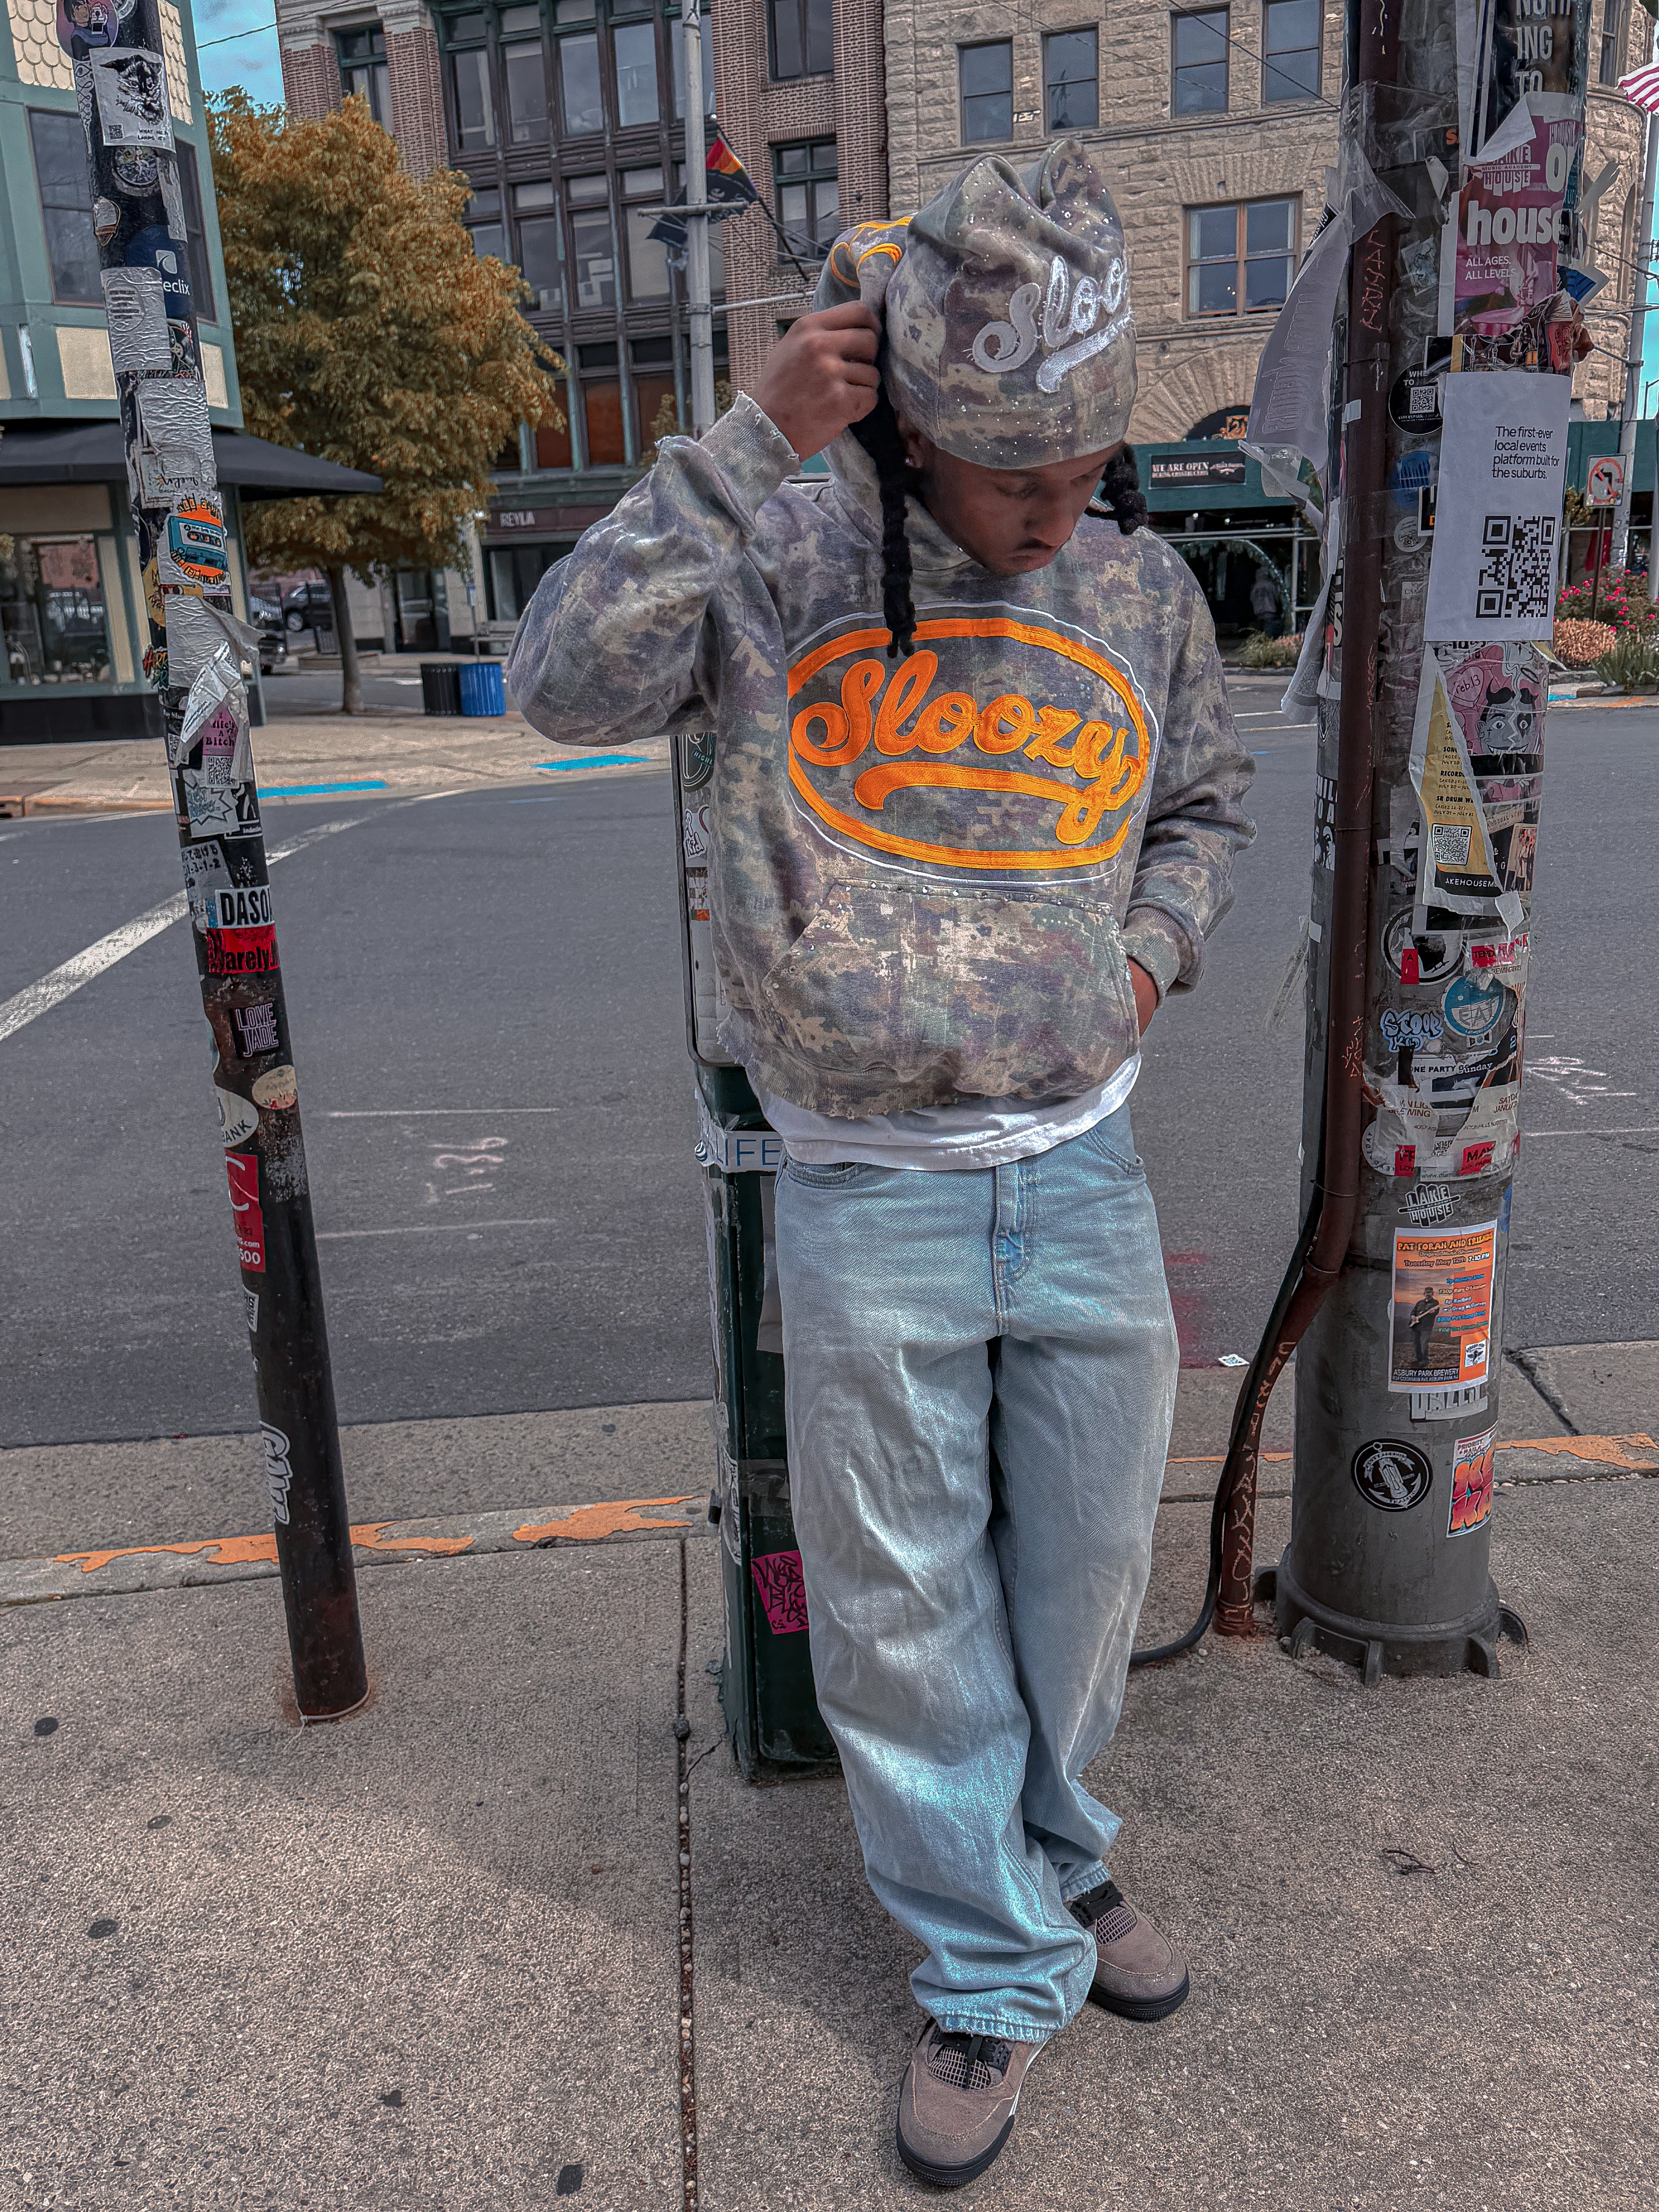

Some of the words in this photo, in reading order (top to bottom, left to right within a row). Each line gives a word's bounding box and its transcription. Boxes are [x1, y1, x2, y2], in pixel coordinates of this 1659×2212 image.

[1517, 25, 1553, 60] ING
[1484, 171, 1529, 185] HOUSE
[1466, 258, 1483, 267] ALL
[1465, 270, 1482, 280] ALL
[1484, 268, 1516, 279] LEVELS
[1495, 426, 1517, 437] The
[1518, 426, 1553, 439] first-ever
[1494, 439, 1519, 451] local
[1520, 441, 1546, 452] events
[1493, 453, 1535, 468] platform
[1536, 454, 1551, 466] built
[1551, 455, 1560, 466] for
[1492, 467, 1510, 478] the
[1511, 467, 1547, 479] suburbs.
[791, 650, 1141, 844] Sloozy
[220, 890, 270, 926] DASO
[235, 1003, 276, 1031] LOVE
[243, 1024, 278, 1057] JADE
[1408, 1187, 1448, 1207] LAKE
[1412, 1202, 1451, 1221] HOUSE
[1398, 1242, 1414, 1250] PAT
[1417, 1241, 1447, 1250] FORAN
[1449, 1239, 1466, 1249] AND
[1433, 1368, 1459, 1376] BREWERY
